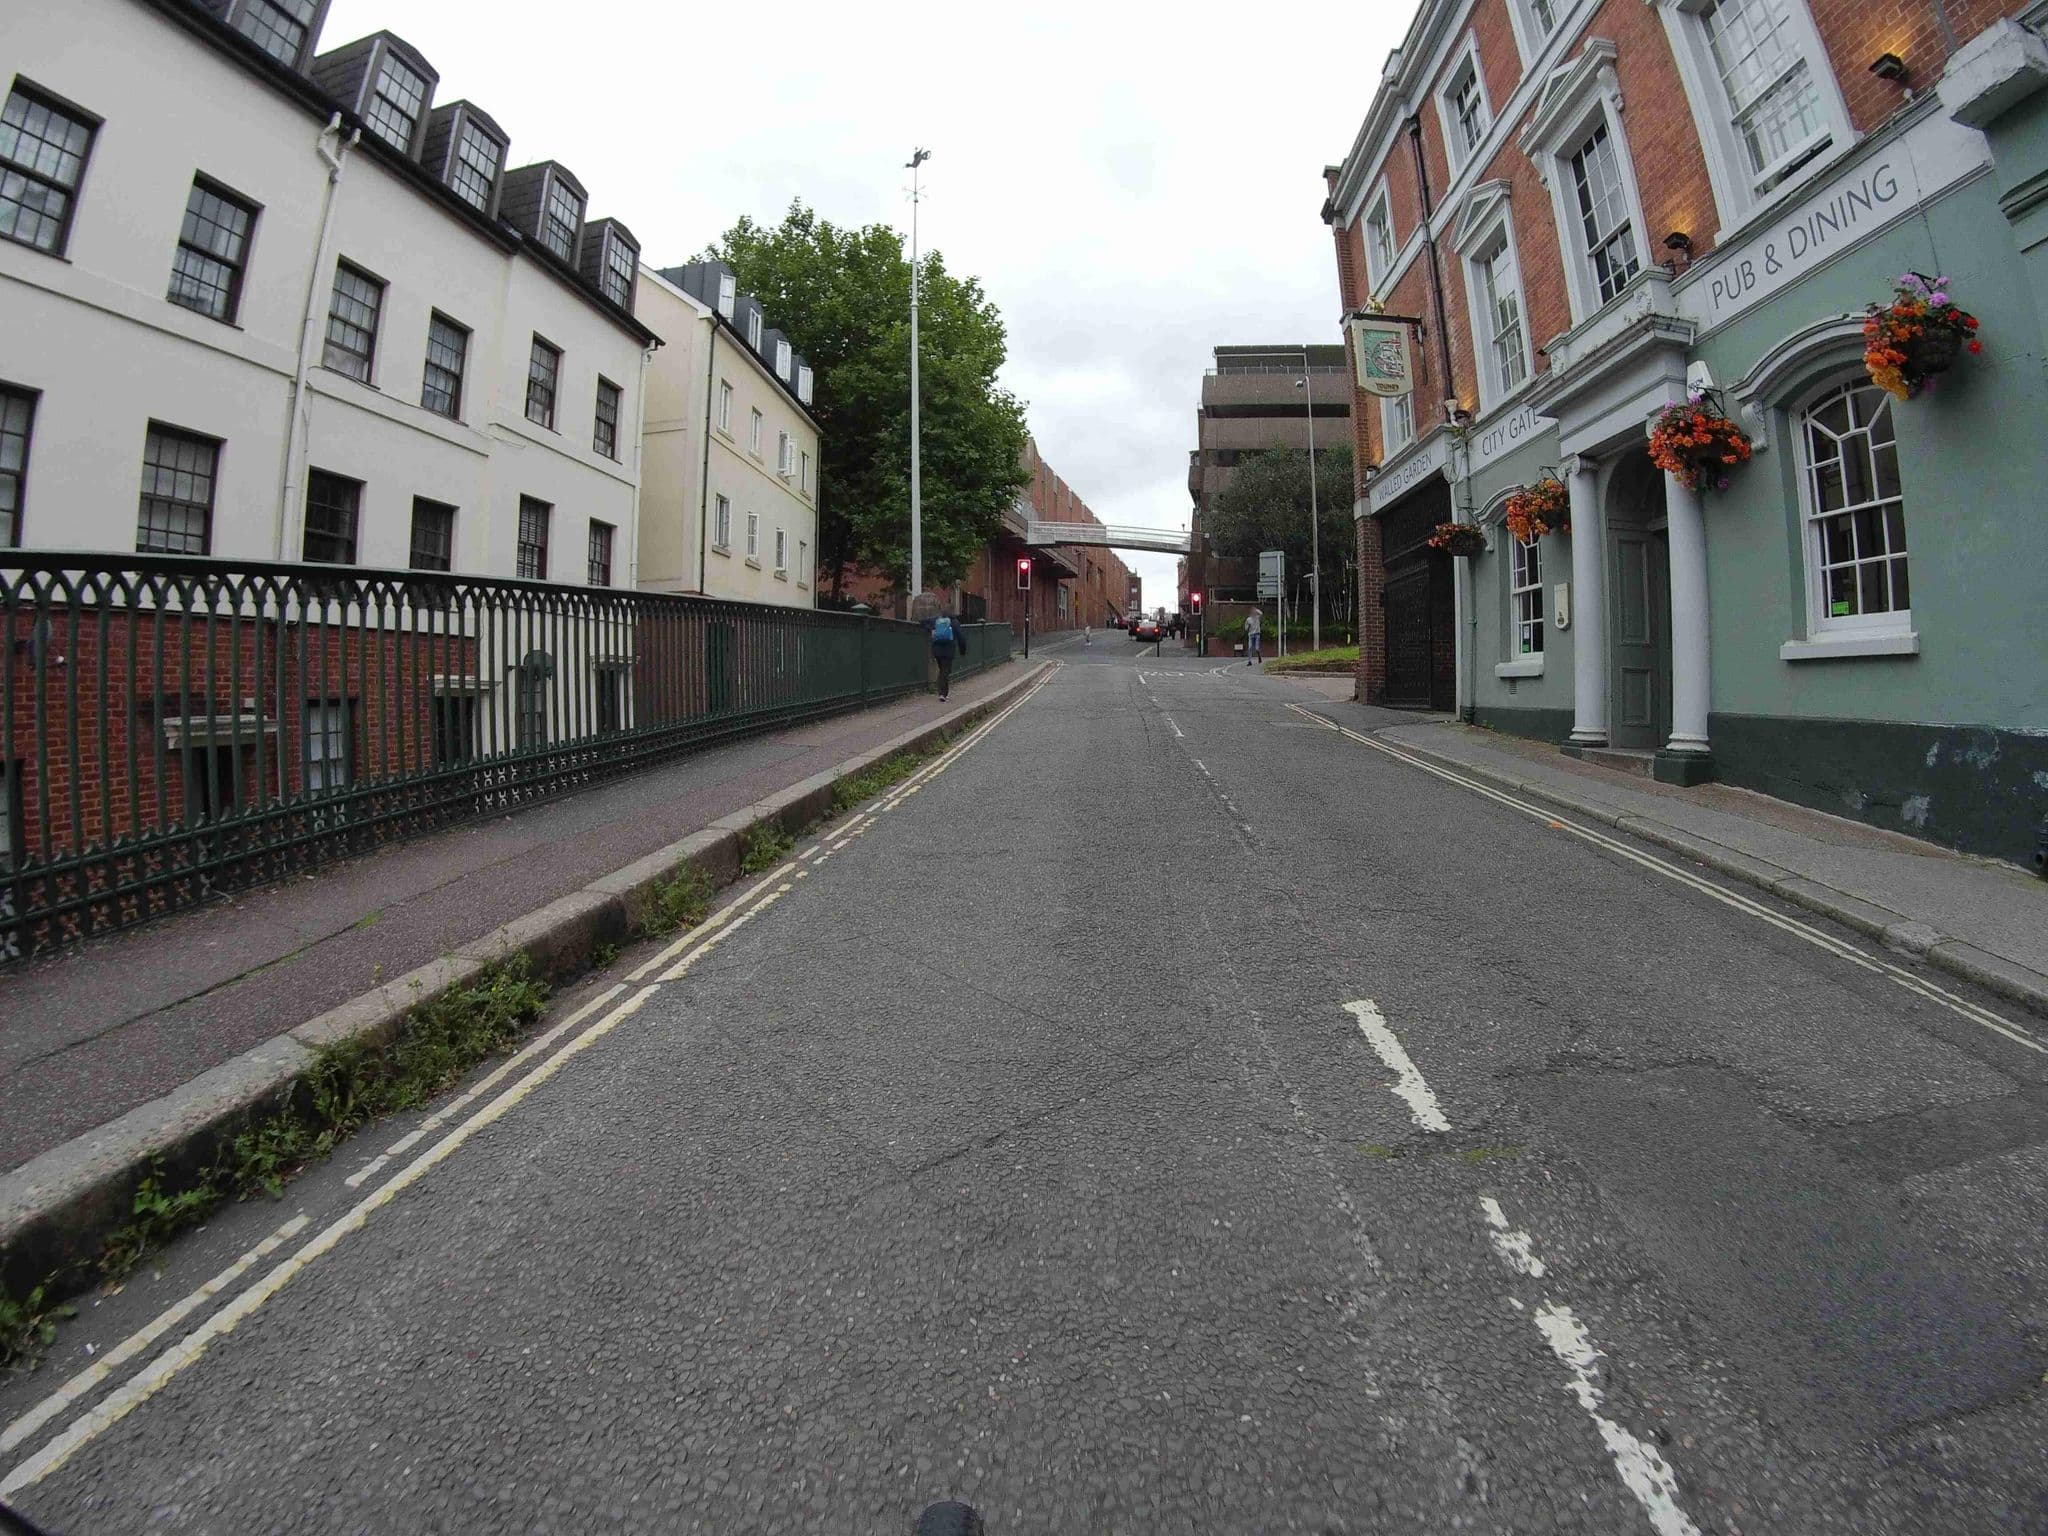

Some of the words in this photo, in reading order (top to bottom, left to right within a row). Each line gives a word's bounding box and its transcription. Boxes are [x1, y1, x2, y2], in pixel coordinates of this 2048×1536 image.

[1711, 260, 1756, 310] PUB
[1764, 243, 1783, 275] &
[1787, 164, 1898, 260] DINING
[1482, 424, 1506, 456] CITY
[1379, 473, 1402, 501] WALLED
[1404, 451, 1432, 484] GARDEN
